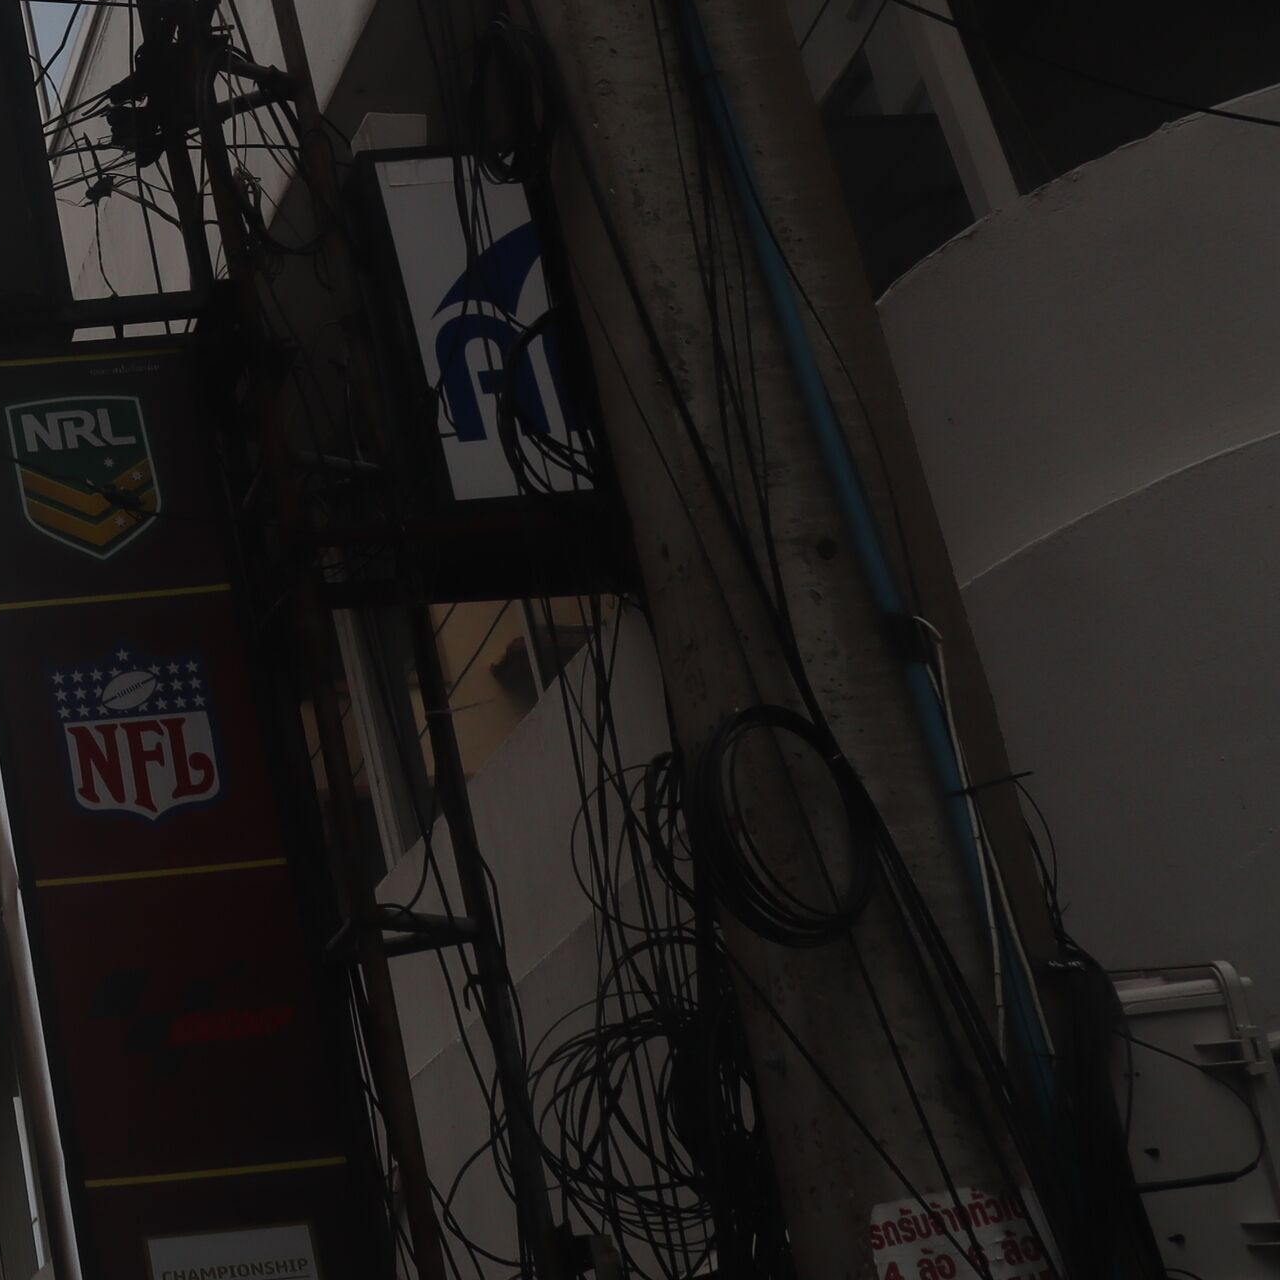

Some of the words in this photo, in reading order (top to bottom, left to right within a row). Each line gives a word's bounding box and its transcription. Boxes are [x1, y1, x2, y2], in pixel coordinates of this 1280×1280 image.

[20, 407, 137, 453] NRL
[67, 717, 216, 813] NFL
[161, 1258, 309, 1280] CHAMPIONSHIP
